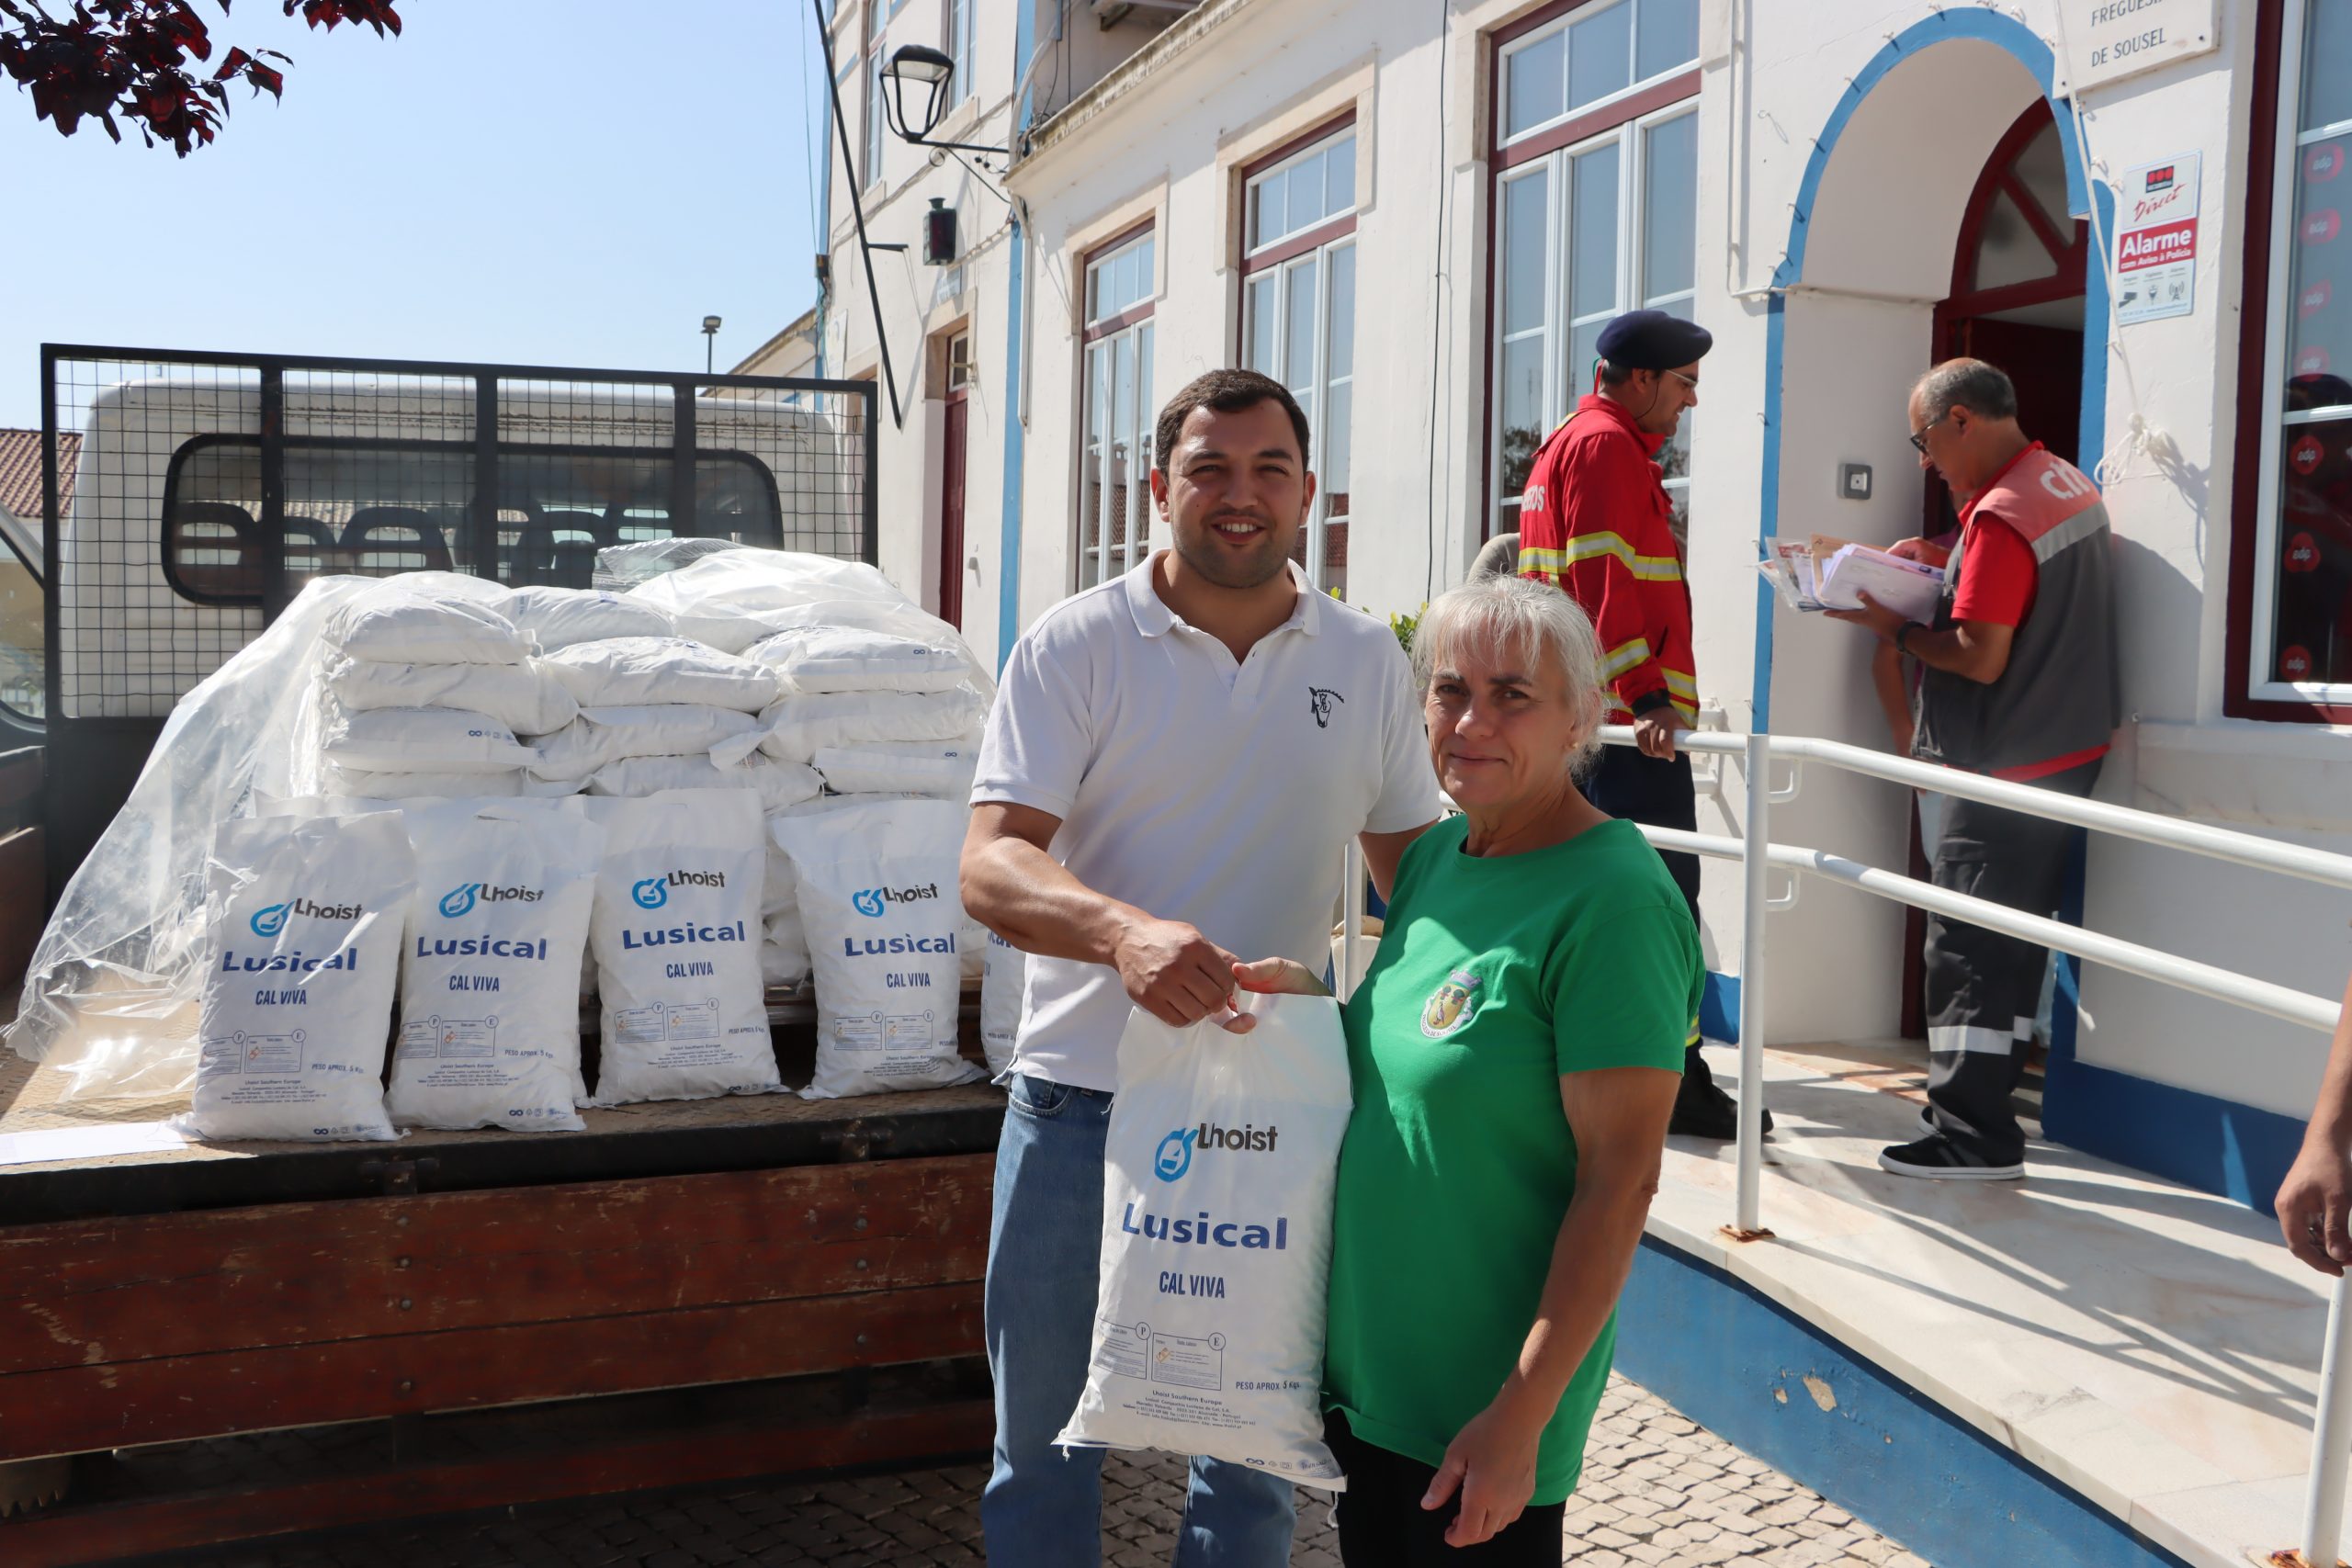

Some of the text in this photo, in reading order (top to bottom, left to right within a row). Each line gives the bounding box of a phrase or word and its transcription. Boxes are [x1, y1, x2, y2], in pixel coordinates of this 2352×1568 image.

[2091, 28, 2166, 67] DE SOUSEL
[2120, 230, 2191, 257] Alarme
[668, 869, 726, 888] Lhoist
[480, 882, 544, 902] Lhoist
[883, 883, 938, 904] Lhoist
[293, 897, 363, 920] Lhoist
[623, 920, 746, 950] Lusical
[844, 932, 956, 957] Lusical
[417, 935, 547, 961] Lusical
[222, 947, 356, 972] Lusical
[666, 961, 713, 978] CAL VIVA
[448, 975, 500, 992] CAL VIVA
[887, 972, 931, 987] CAL VIVA
[255, 989, 307, 1005] CAL VIVA
[1197, 1122, 1278, 1152] Lhoist
[1121, 1203, 1287, 1250] Lusical
[1159, 1271, 1226, 1299] CAL VIVA
[1214, 1337, 1220, 1346] E
[1236, 1382, 1254, 1390] PESO
[1200, 1397, 1222, 1405] Europe
